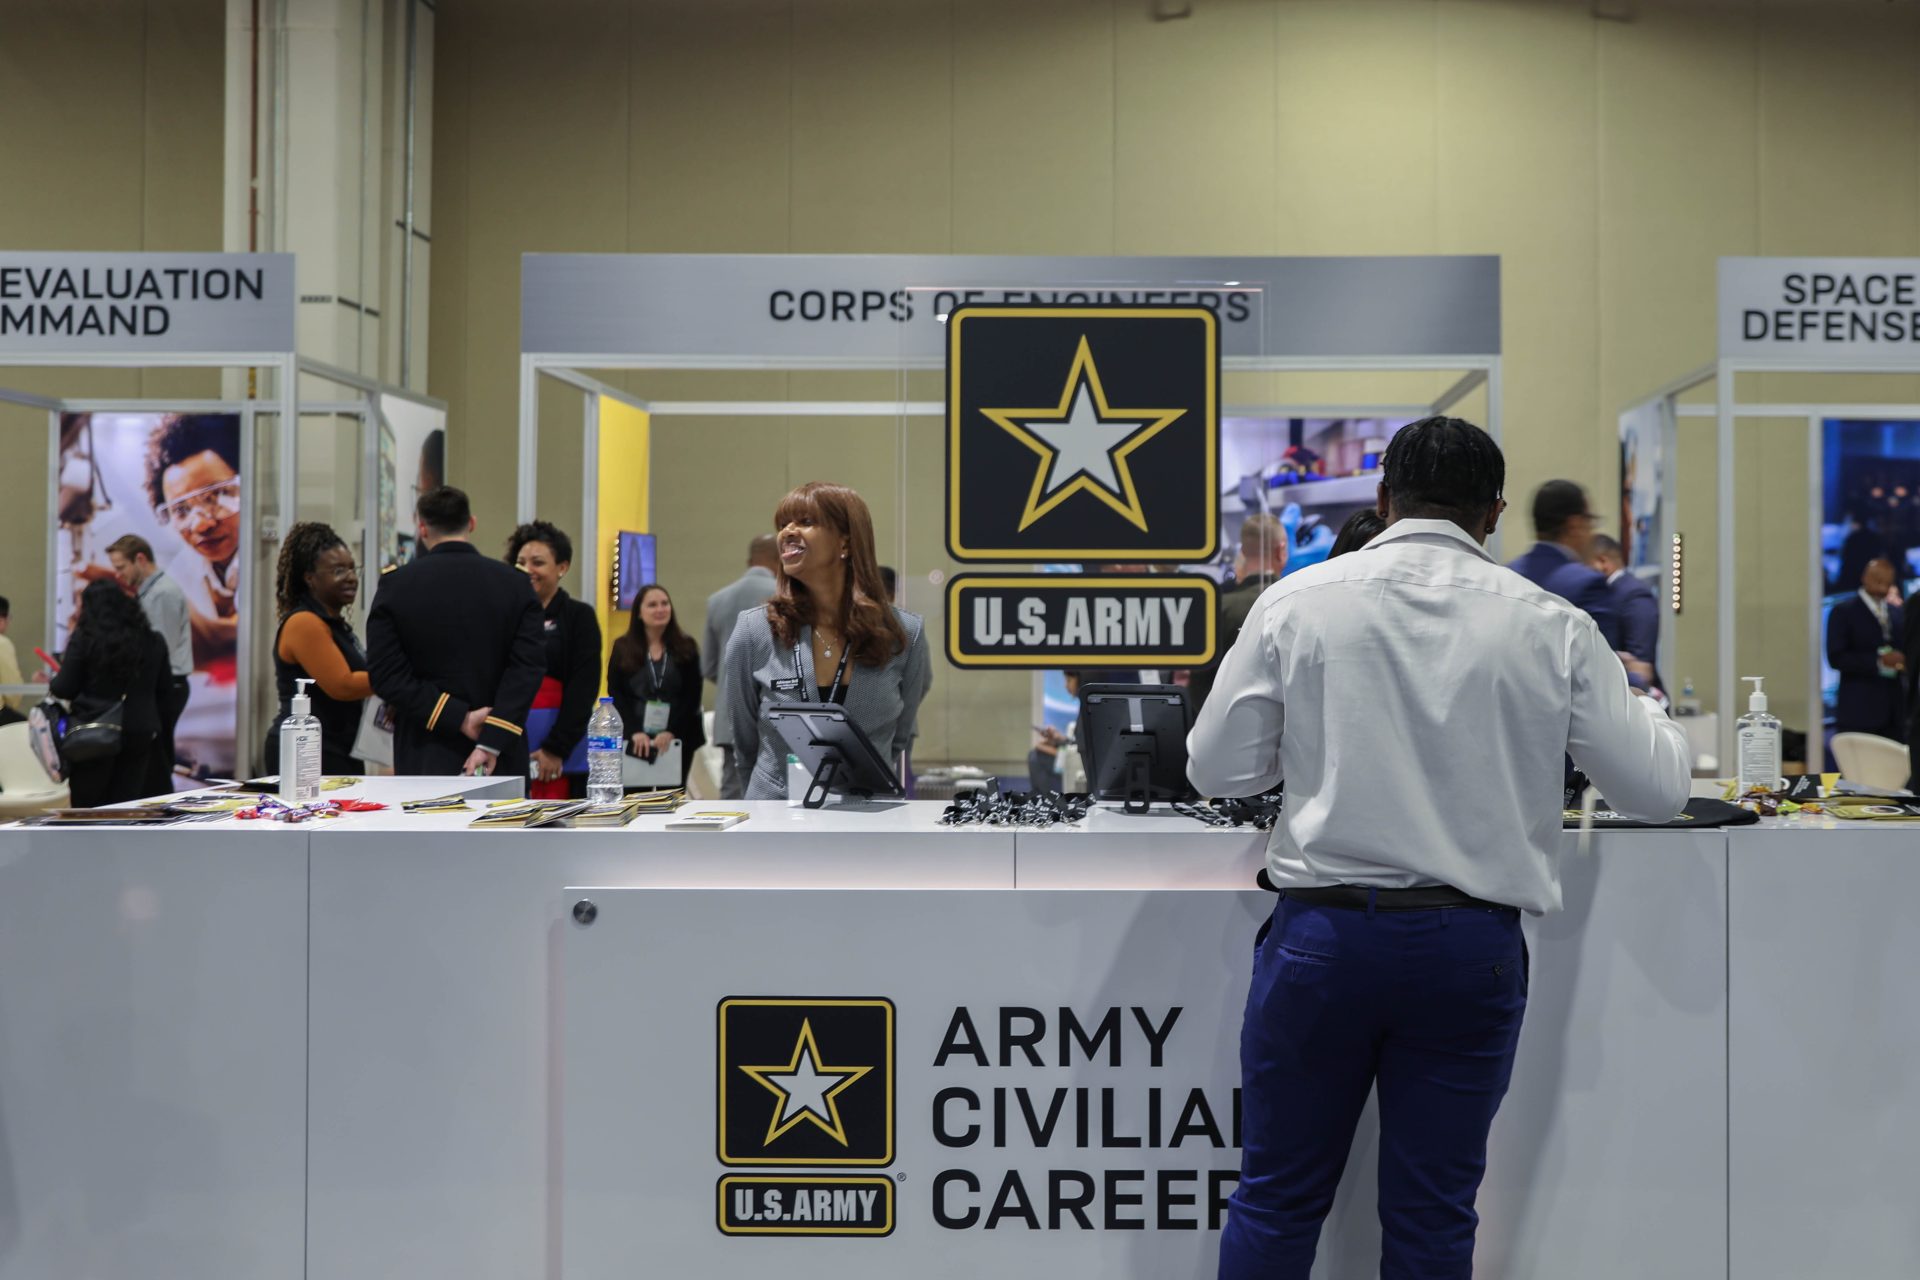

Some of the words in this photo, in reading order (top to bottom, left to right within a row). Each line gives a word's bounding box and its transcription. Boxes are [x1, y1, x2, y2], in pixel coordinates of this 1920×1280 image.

[1, 268, 263, 300] EVALUATION
[1784, 274, 1914, 305] SPACE
[1, 304, 169, 335] MMAND
[770, 289, 914, 322] CORPS
[973, 597, 1192, 646] U.S.ARMY
[933, 1007, 1184, 1067] ARMY
[932, 1087, 1241, 1148] CIVILIA
[734, 1189, 877, 1222] U.S.ARMY
